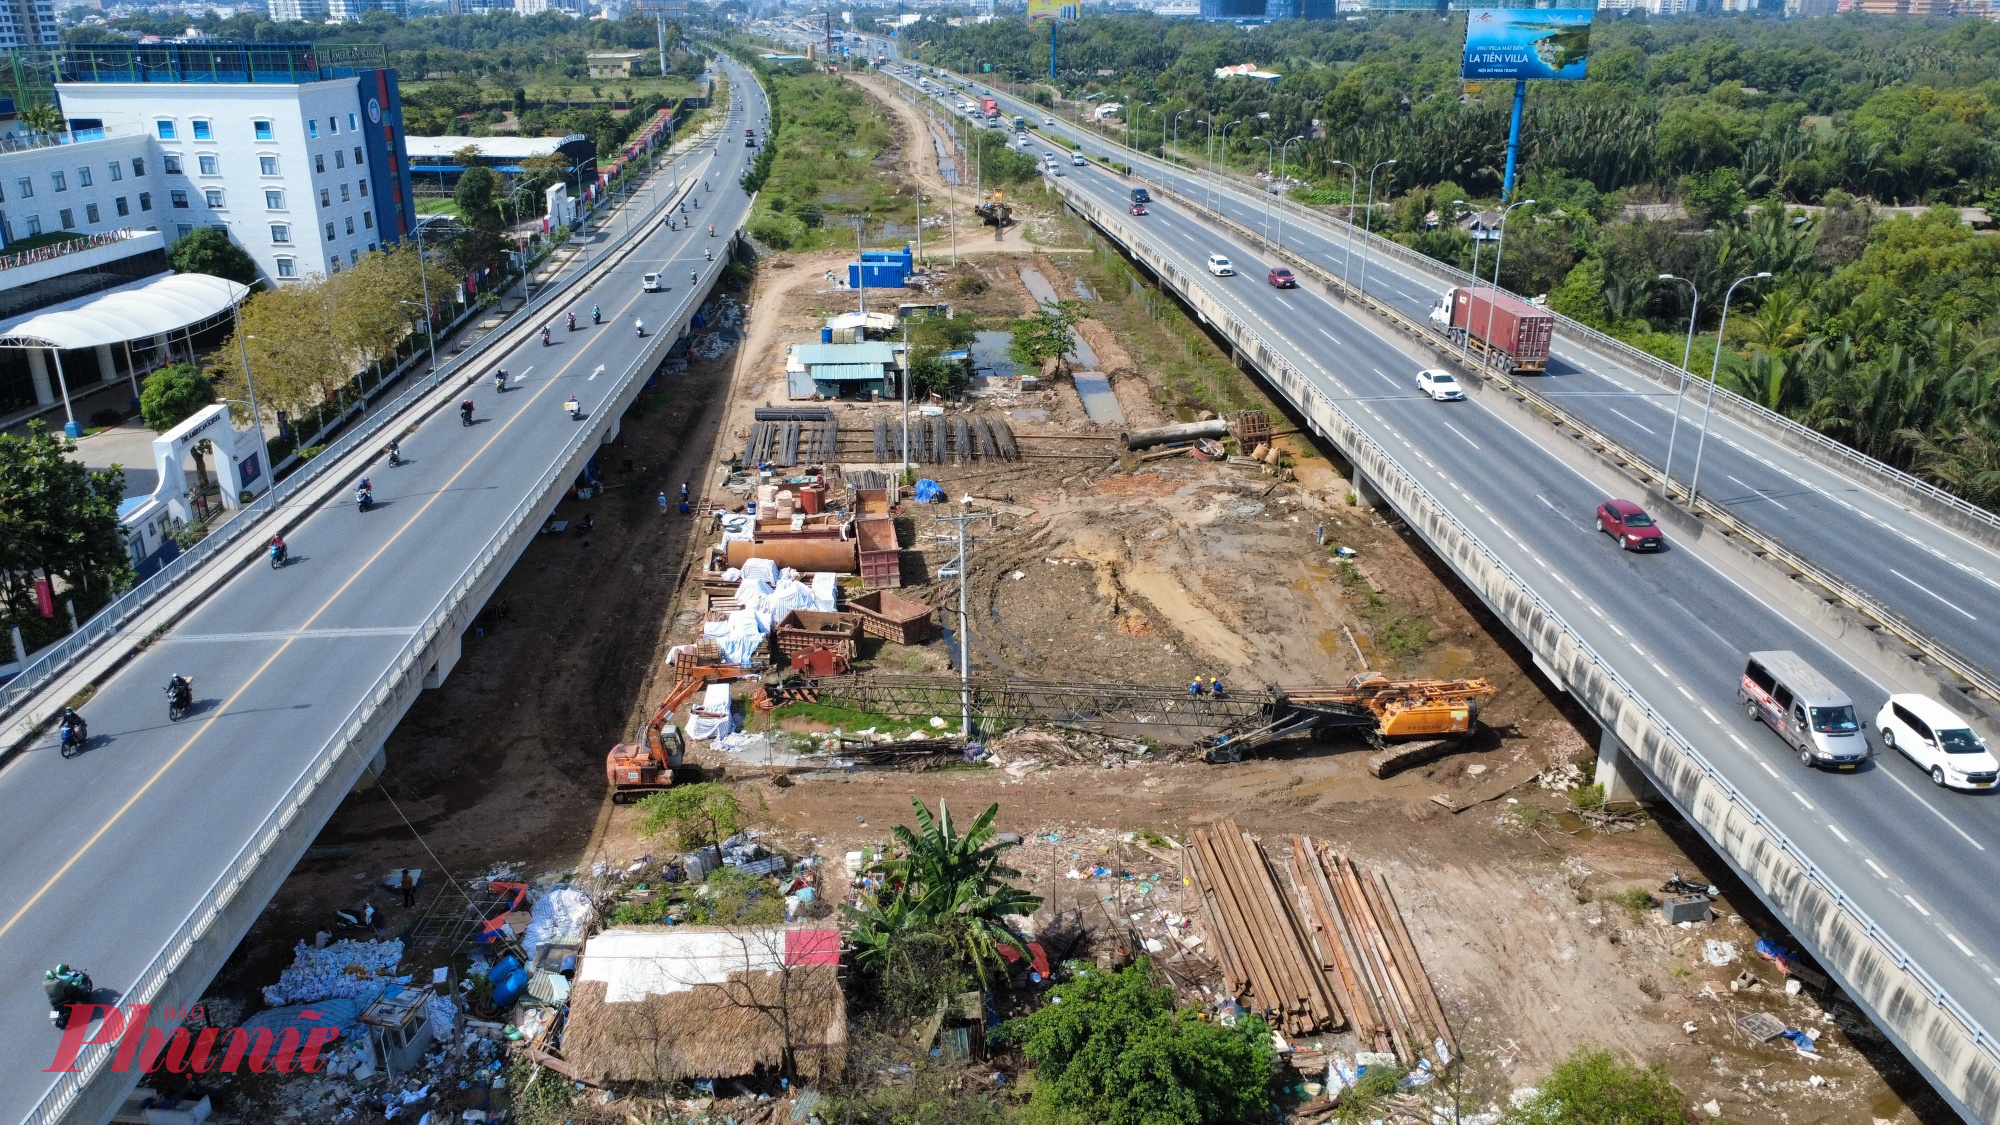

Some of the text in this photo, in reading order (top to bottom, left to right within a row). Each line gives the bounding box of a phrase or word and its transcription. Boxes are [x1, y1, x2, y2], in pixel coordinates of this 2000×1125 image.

[1469, 54, 1480, 63] LA
[1504, 54, 1528, 63] VILLA
[15, 238, 86, 267] AMERICAN
[89, 227, 133, 248] SCHOOL
